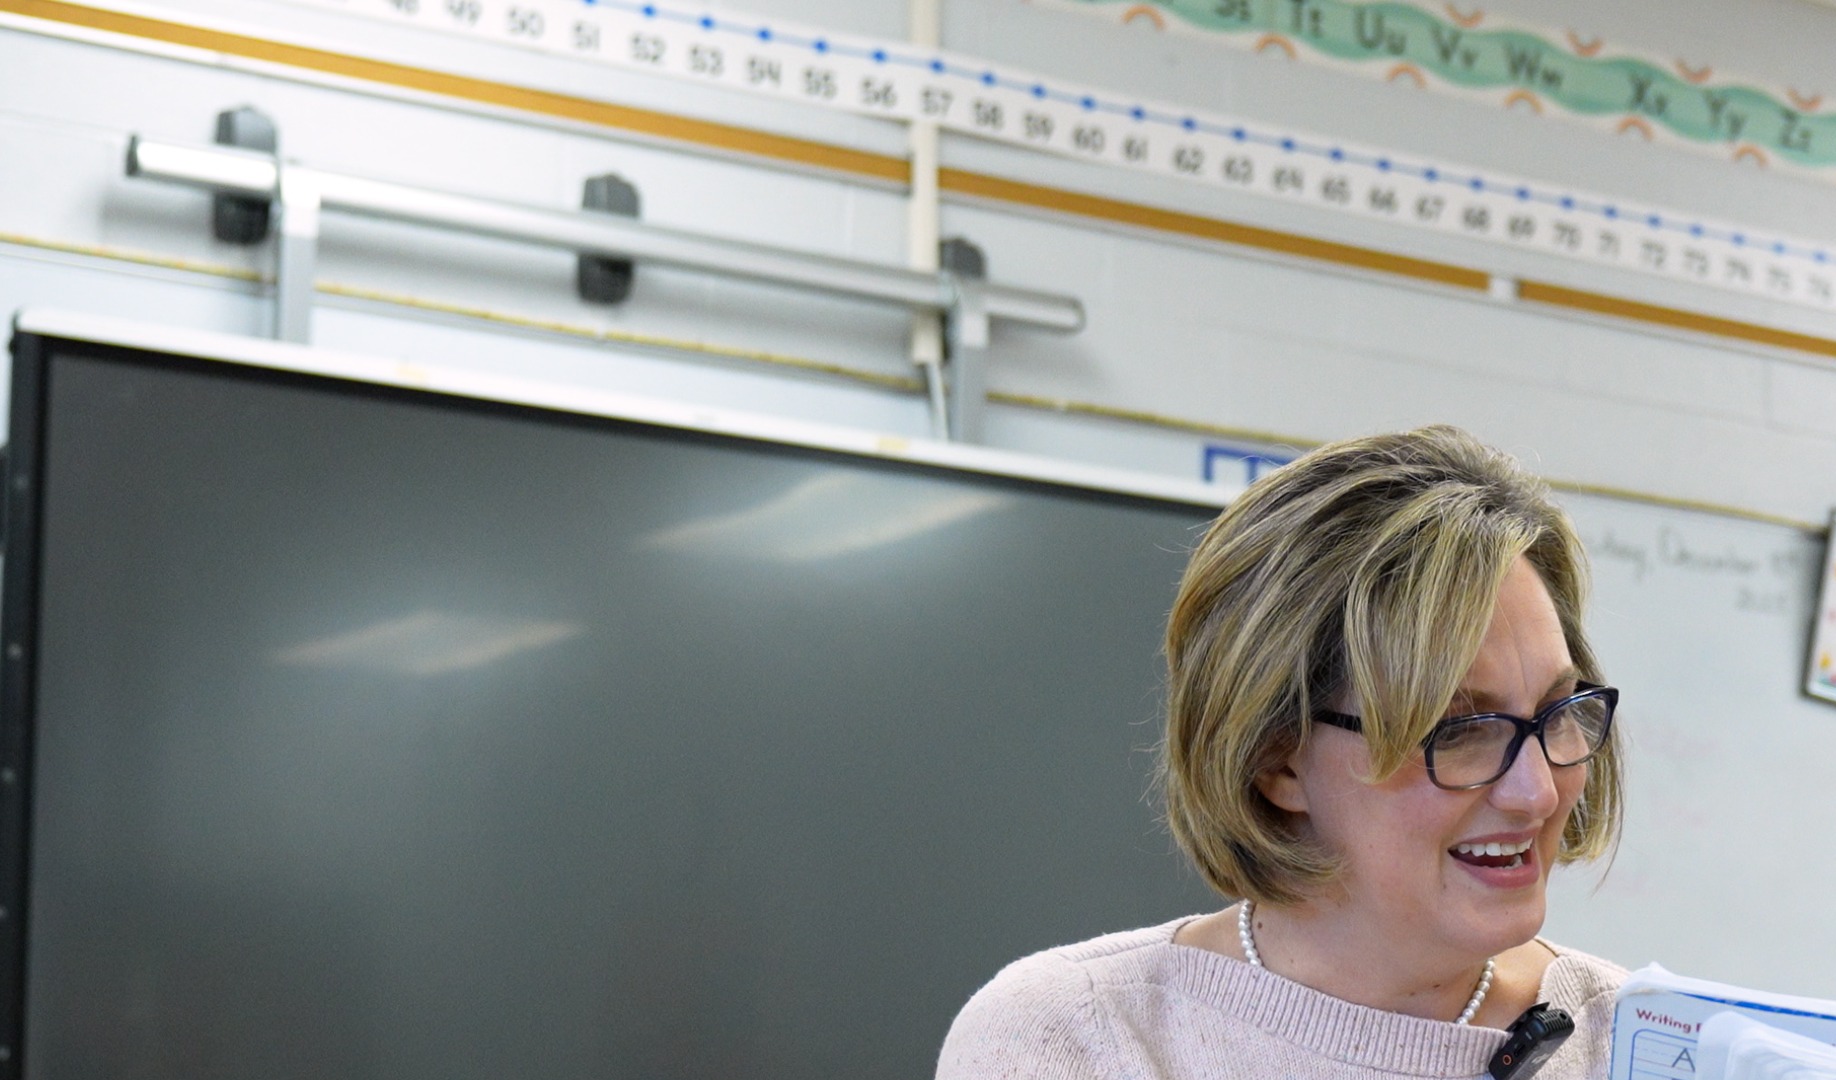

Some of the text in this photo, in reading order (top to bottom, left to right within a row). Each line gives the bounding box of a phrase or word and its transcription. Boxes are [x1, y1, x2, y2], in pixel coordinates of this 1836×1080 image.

[1353, 7, 1407, 56] Uu
[506, 7, 545, 38] 50
[571, 20, 601, 50] 51
[630, 33, 666, 65] 52
[688, 44, 724, 76] 53
[745, 55, 782, 85] 54
[802, 66, 837, 99] 55
[861, 78, 896, 107] 56
[919, 87, 954, 118] 57
[972, 99, 1004, 129] 58
[1022, 111, 1055, 142] 59
[1071, 125, 1106, 153] 60
[1121, 134, 1148, 160] 61
[1171, 146, 1204, 174] 62
[1221, 156, 1254, 184] 63
[1319, 176, 1351, 203] 65
[1413, 195, 1445, 220] 67
[1635, 1008, 1692, 1033] Writing
[1671, 1047, 1696, 1073] A
